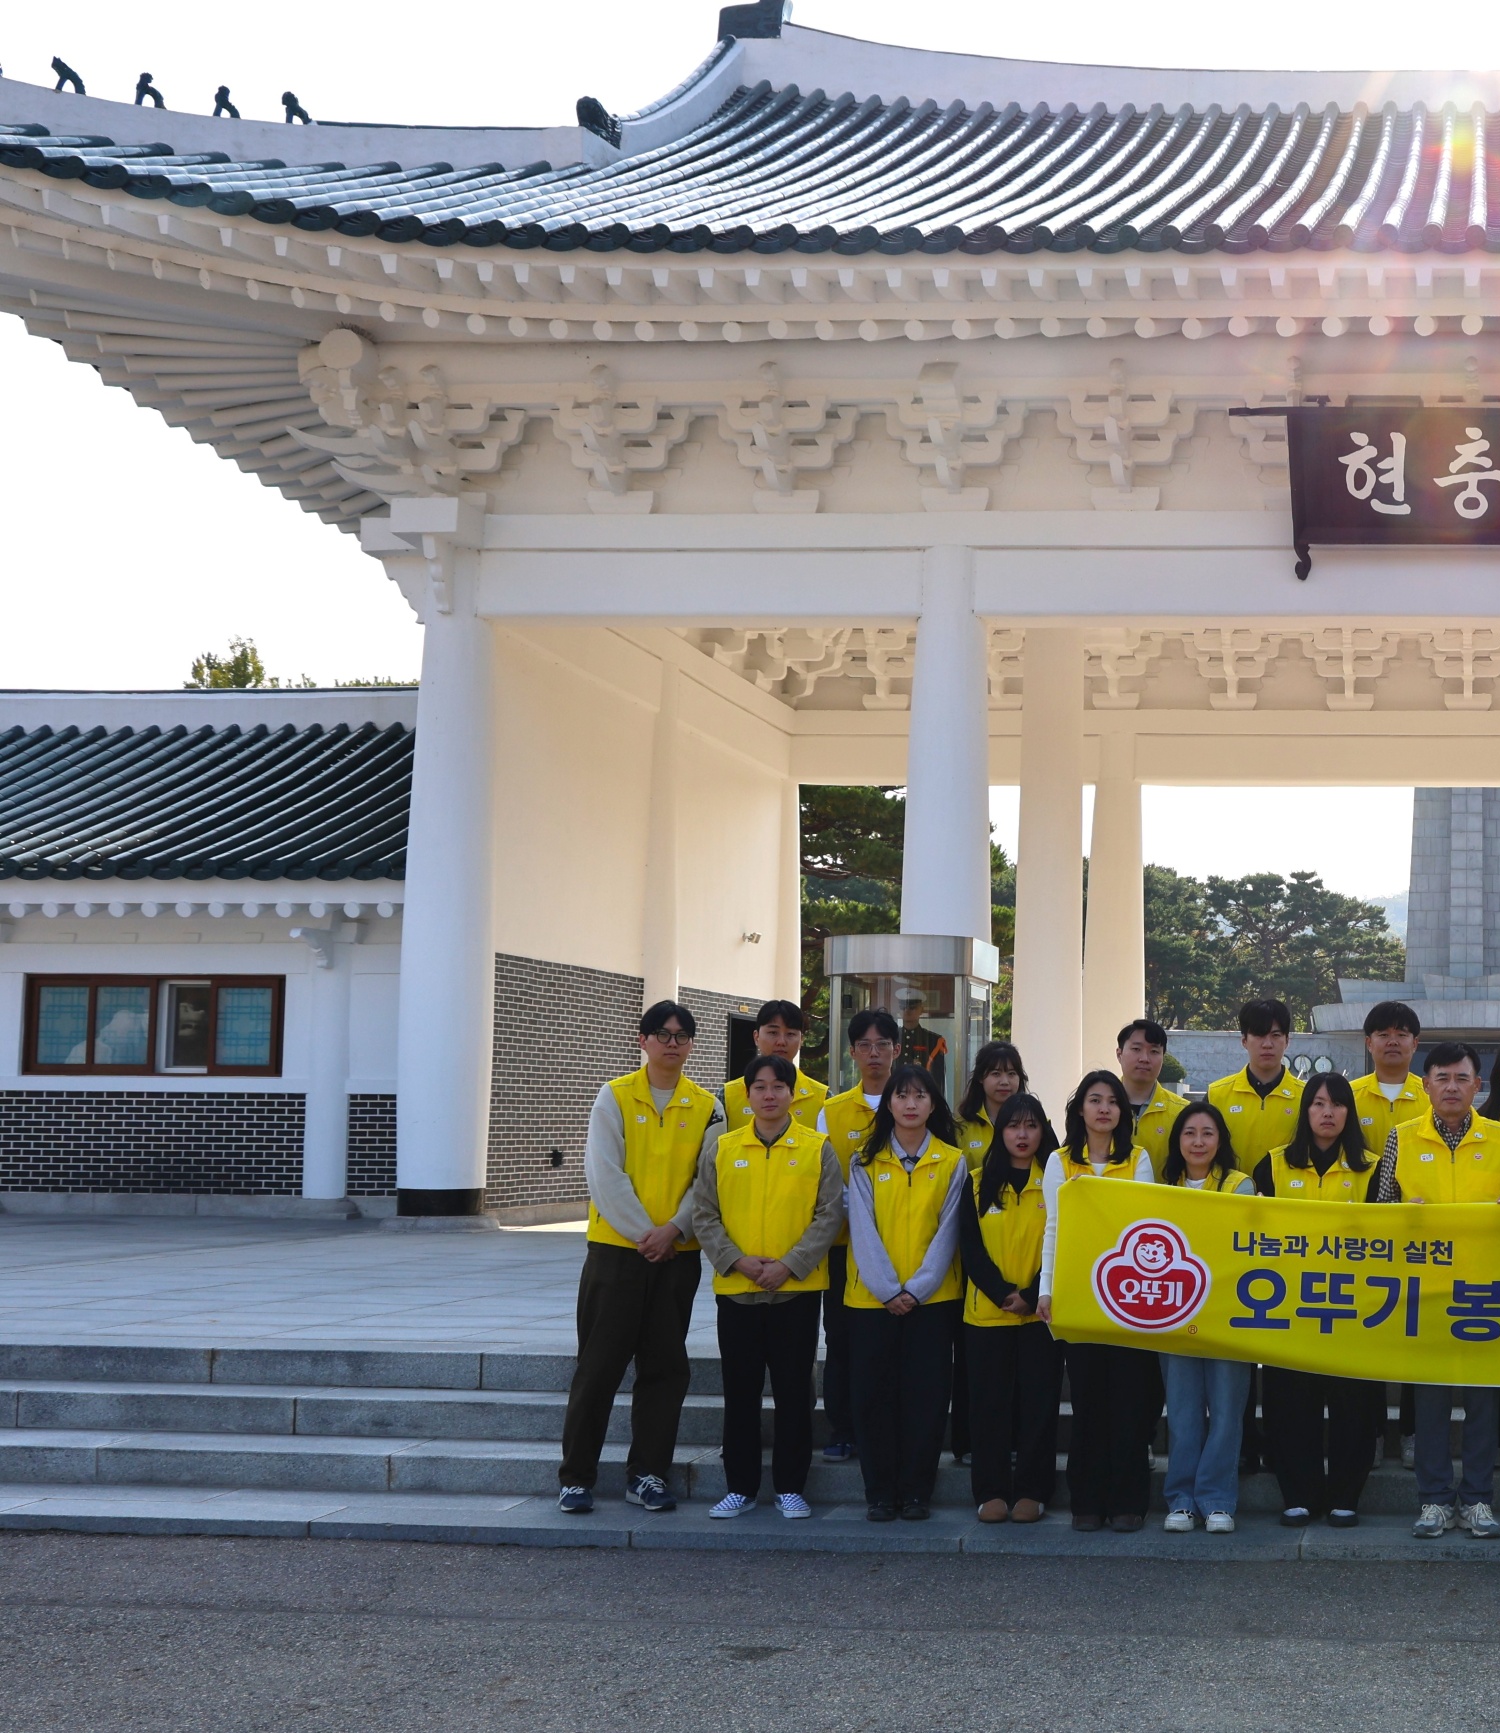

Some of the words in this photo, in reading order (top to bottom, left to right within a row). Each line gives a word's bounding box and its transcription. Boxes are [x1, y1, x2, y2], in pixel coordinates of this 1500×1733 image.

[1233, 1231, 1309, 1257] 나눔과
[1316, 1235, 1394, 1262] 사랑의
[1402, 1240, 1453, 1266] 실천
[1118, 1278, 1183, 1307] 오뚜기
[1229, 1268, 1421, 1337] 오뚜기
